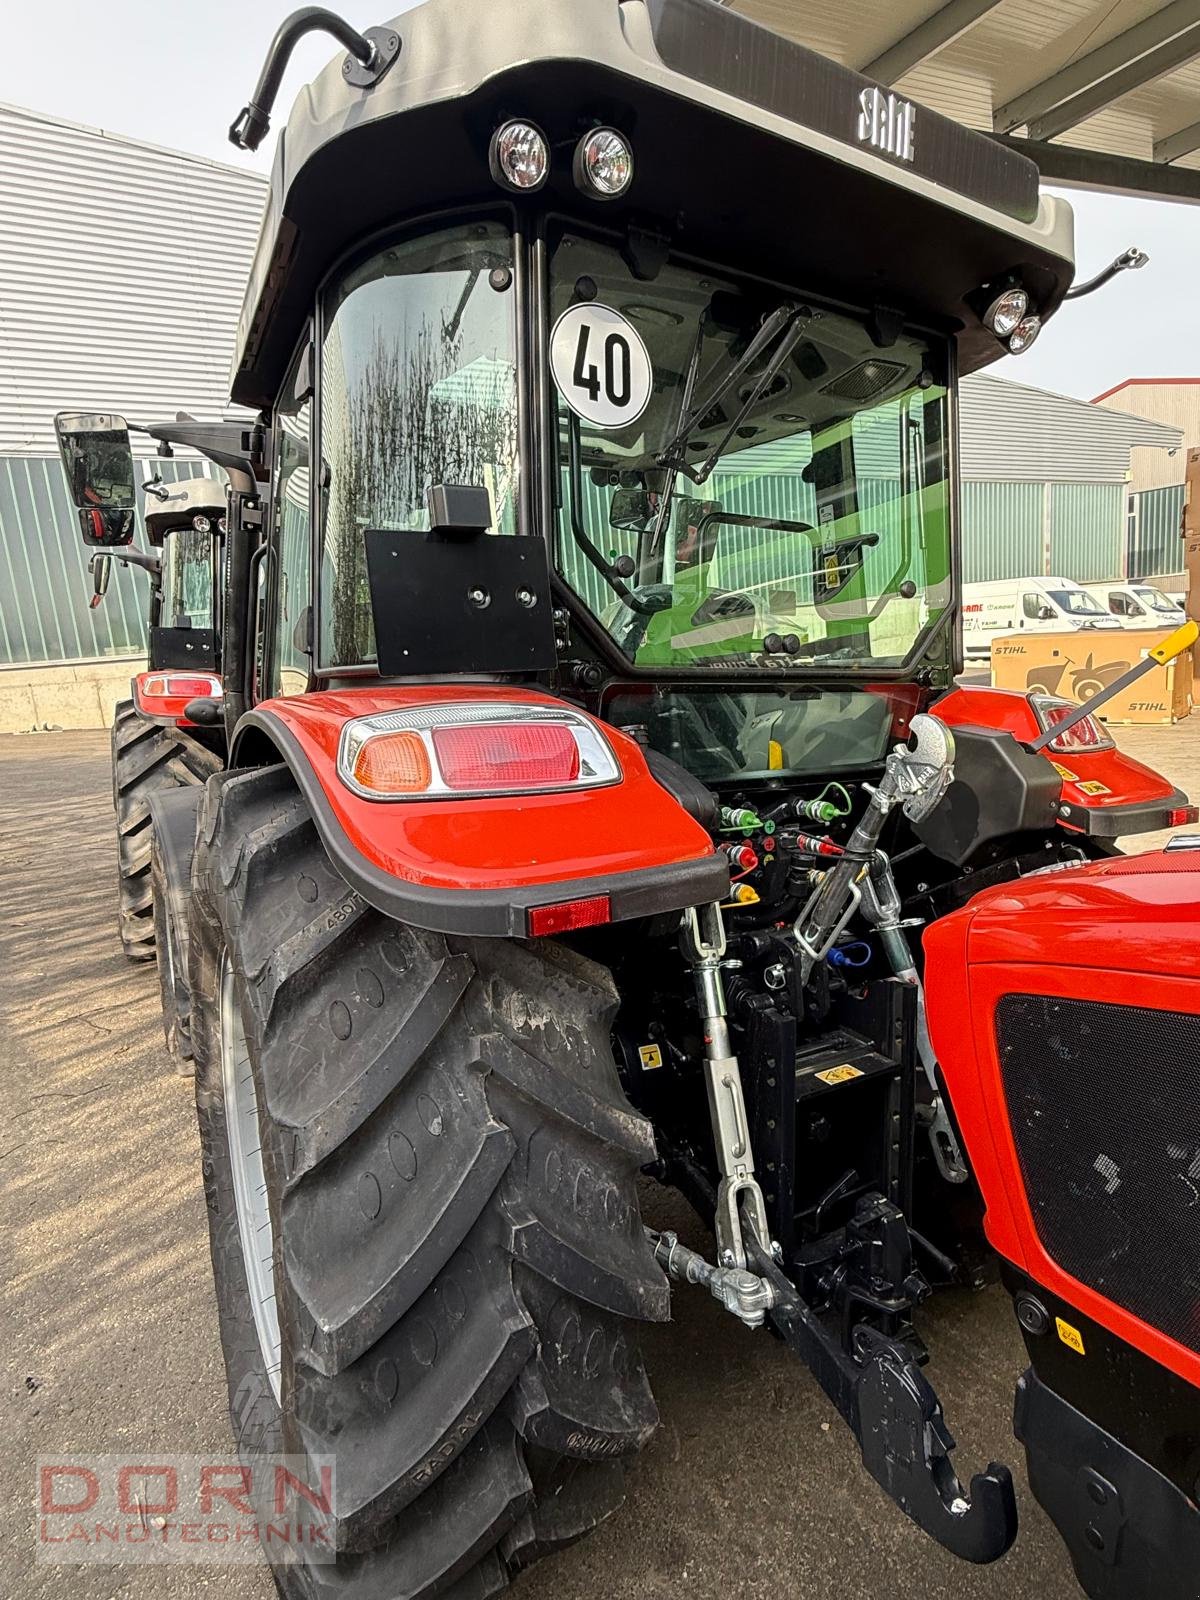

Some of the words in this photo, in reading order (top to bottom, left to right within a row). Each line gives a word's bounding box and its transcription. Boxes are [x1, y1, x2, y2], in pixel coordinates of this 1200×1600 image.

[858, 87, 916, 161] SAME
[573, 324, 631, 407] 40
[994, 646, 1028, 655] STIHL
[1128, 702, 1167, 711] STIHL
